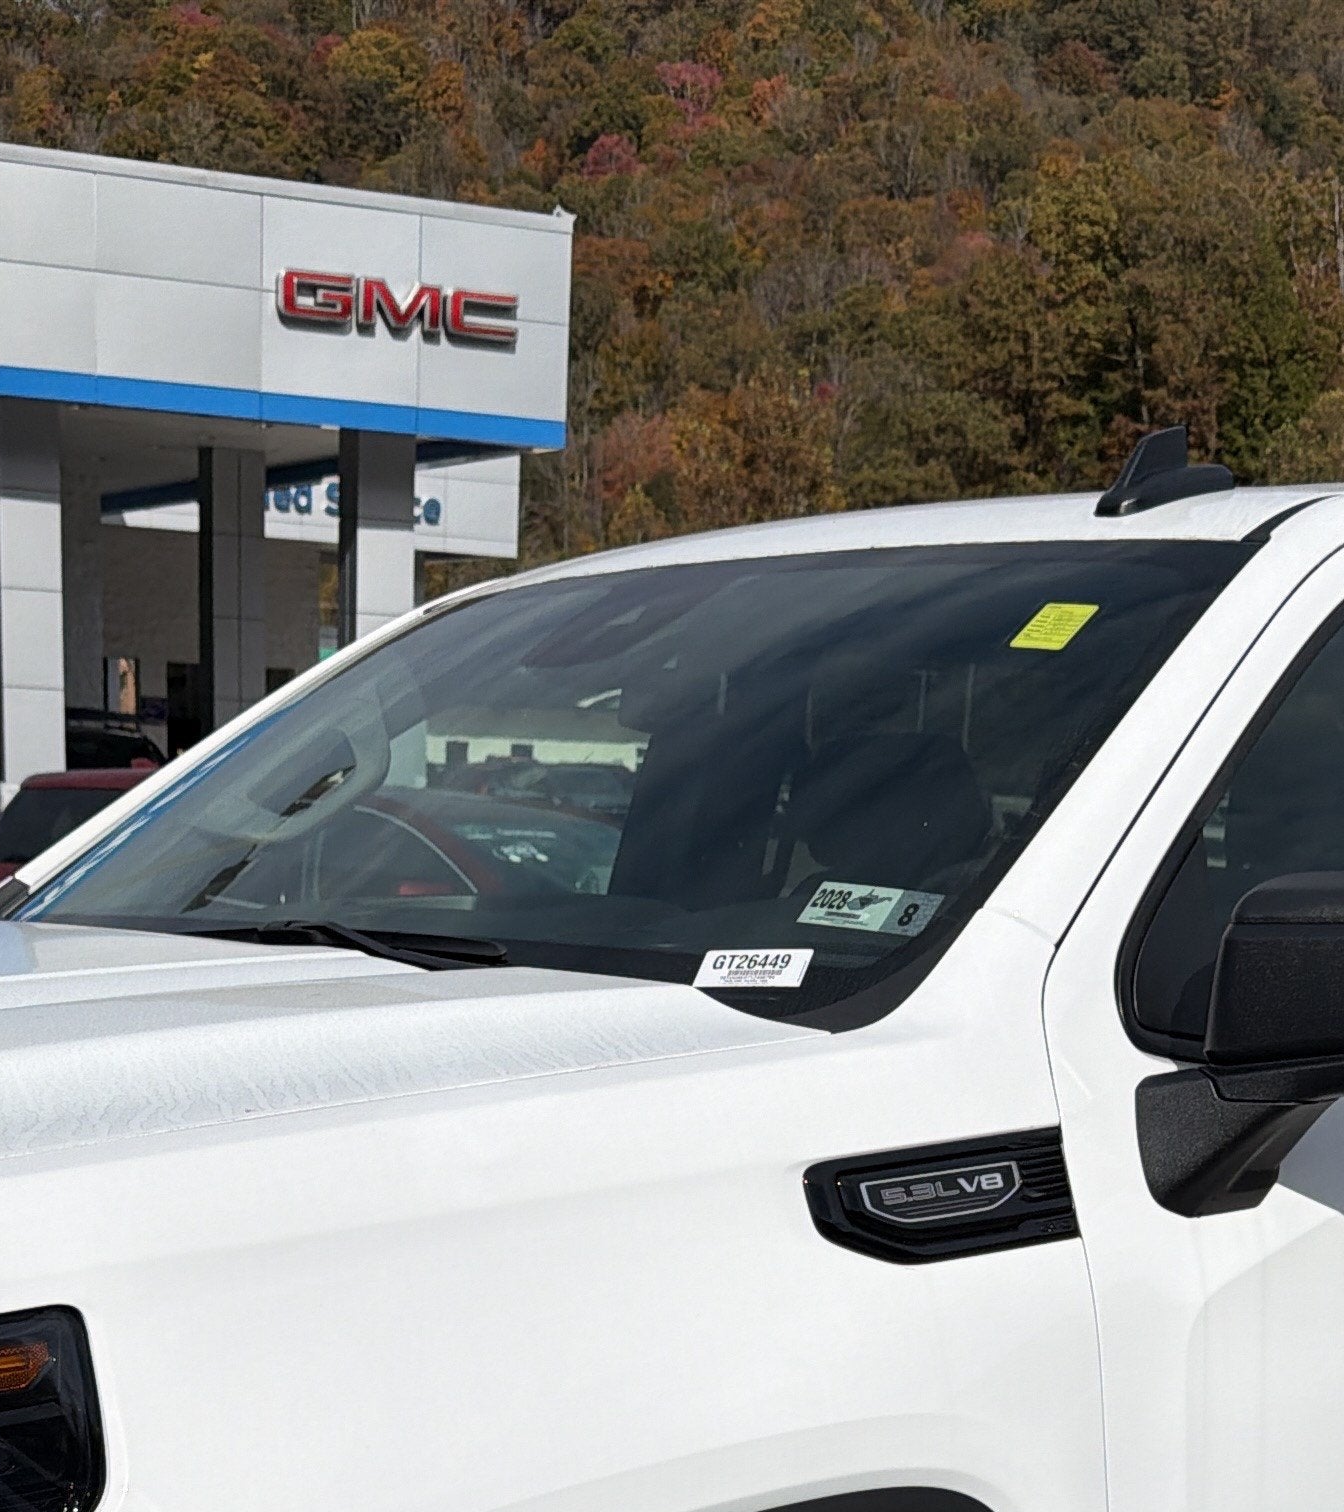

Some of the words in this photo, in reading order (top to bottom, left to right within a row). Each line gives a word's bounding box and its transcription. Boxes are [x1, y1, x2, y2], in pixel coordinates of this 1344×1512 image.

[276, 268, 519, 343] GMC
[810, 888, 852, 910] 2028
[897, 903, 920, 926] 8
[712, 953, 792, 970] GT26449
